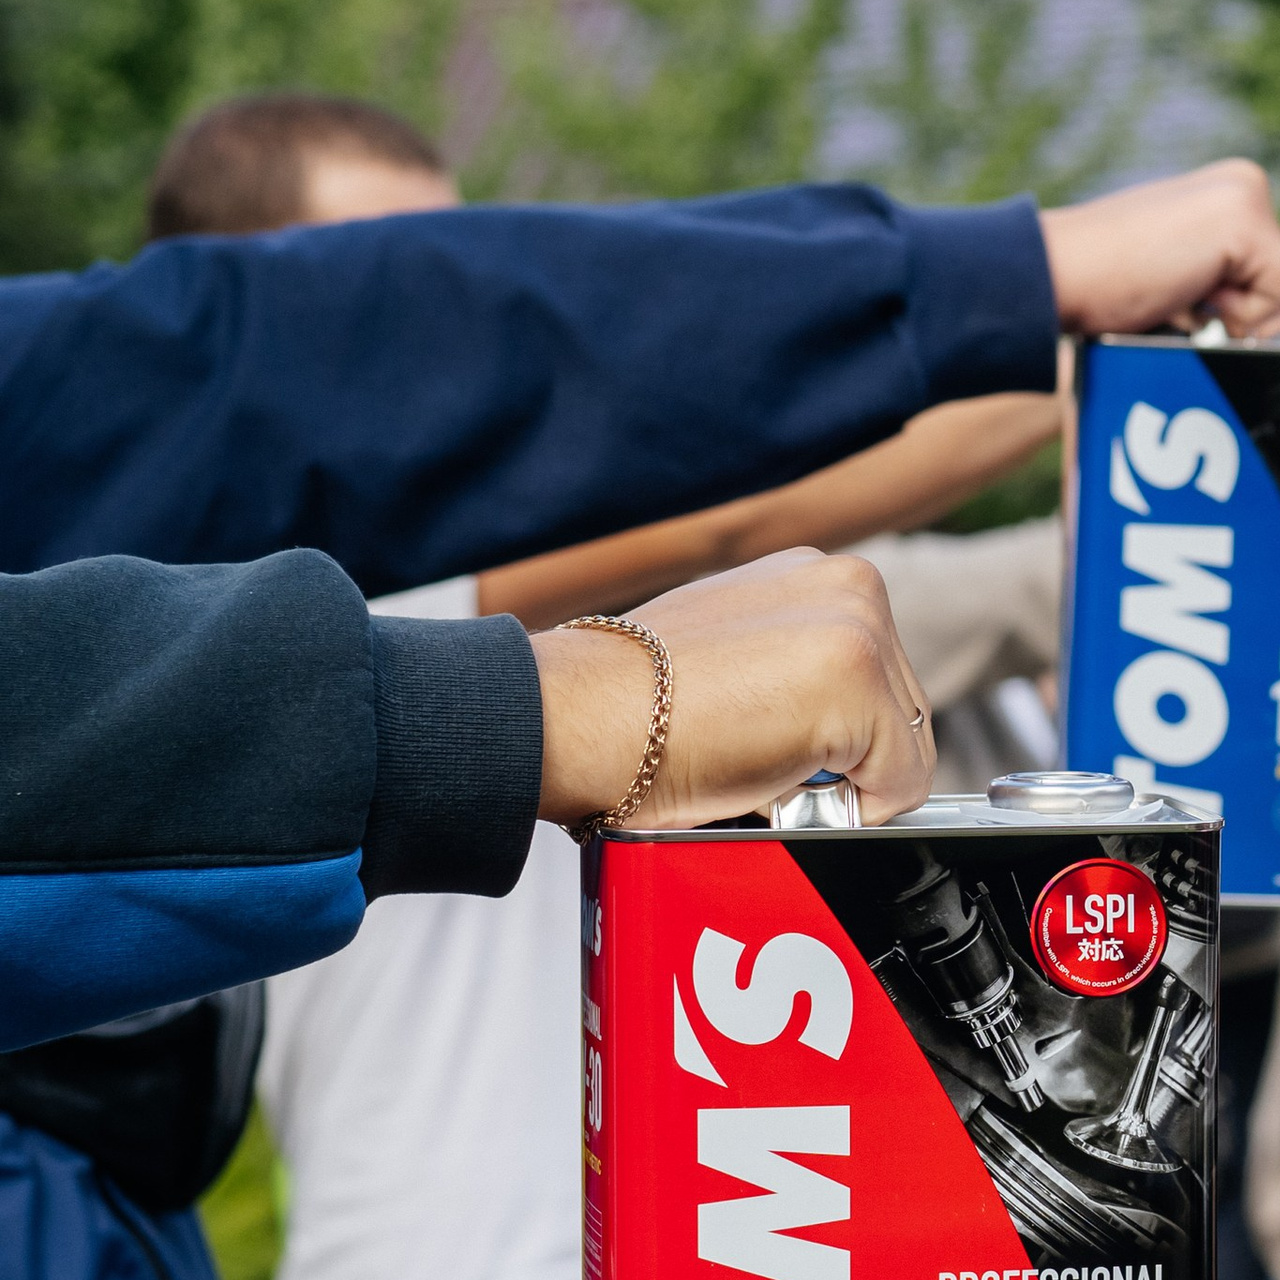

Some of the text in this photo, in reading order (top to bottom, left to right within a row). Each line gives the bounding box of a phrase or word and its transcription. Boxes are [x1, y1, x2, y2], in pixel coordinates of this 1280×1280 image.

[1066, 893, 1135, 934] LSPI
[1042, 907, 1053, 948] Compatible
[1047, 948, 1057, 963] with
[1077, 938, 1124, 962] 対応
[1124, 935, 1157, 979] direct-injection
[1055, 961, 1070, 977] LSPI,
[1071, 974, 1091, 986] which
